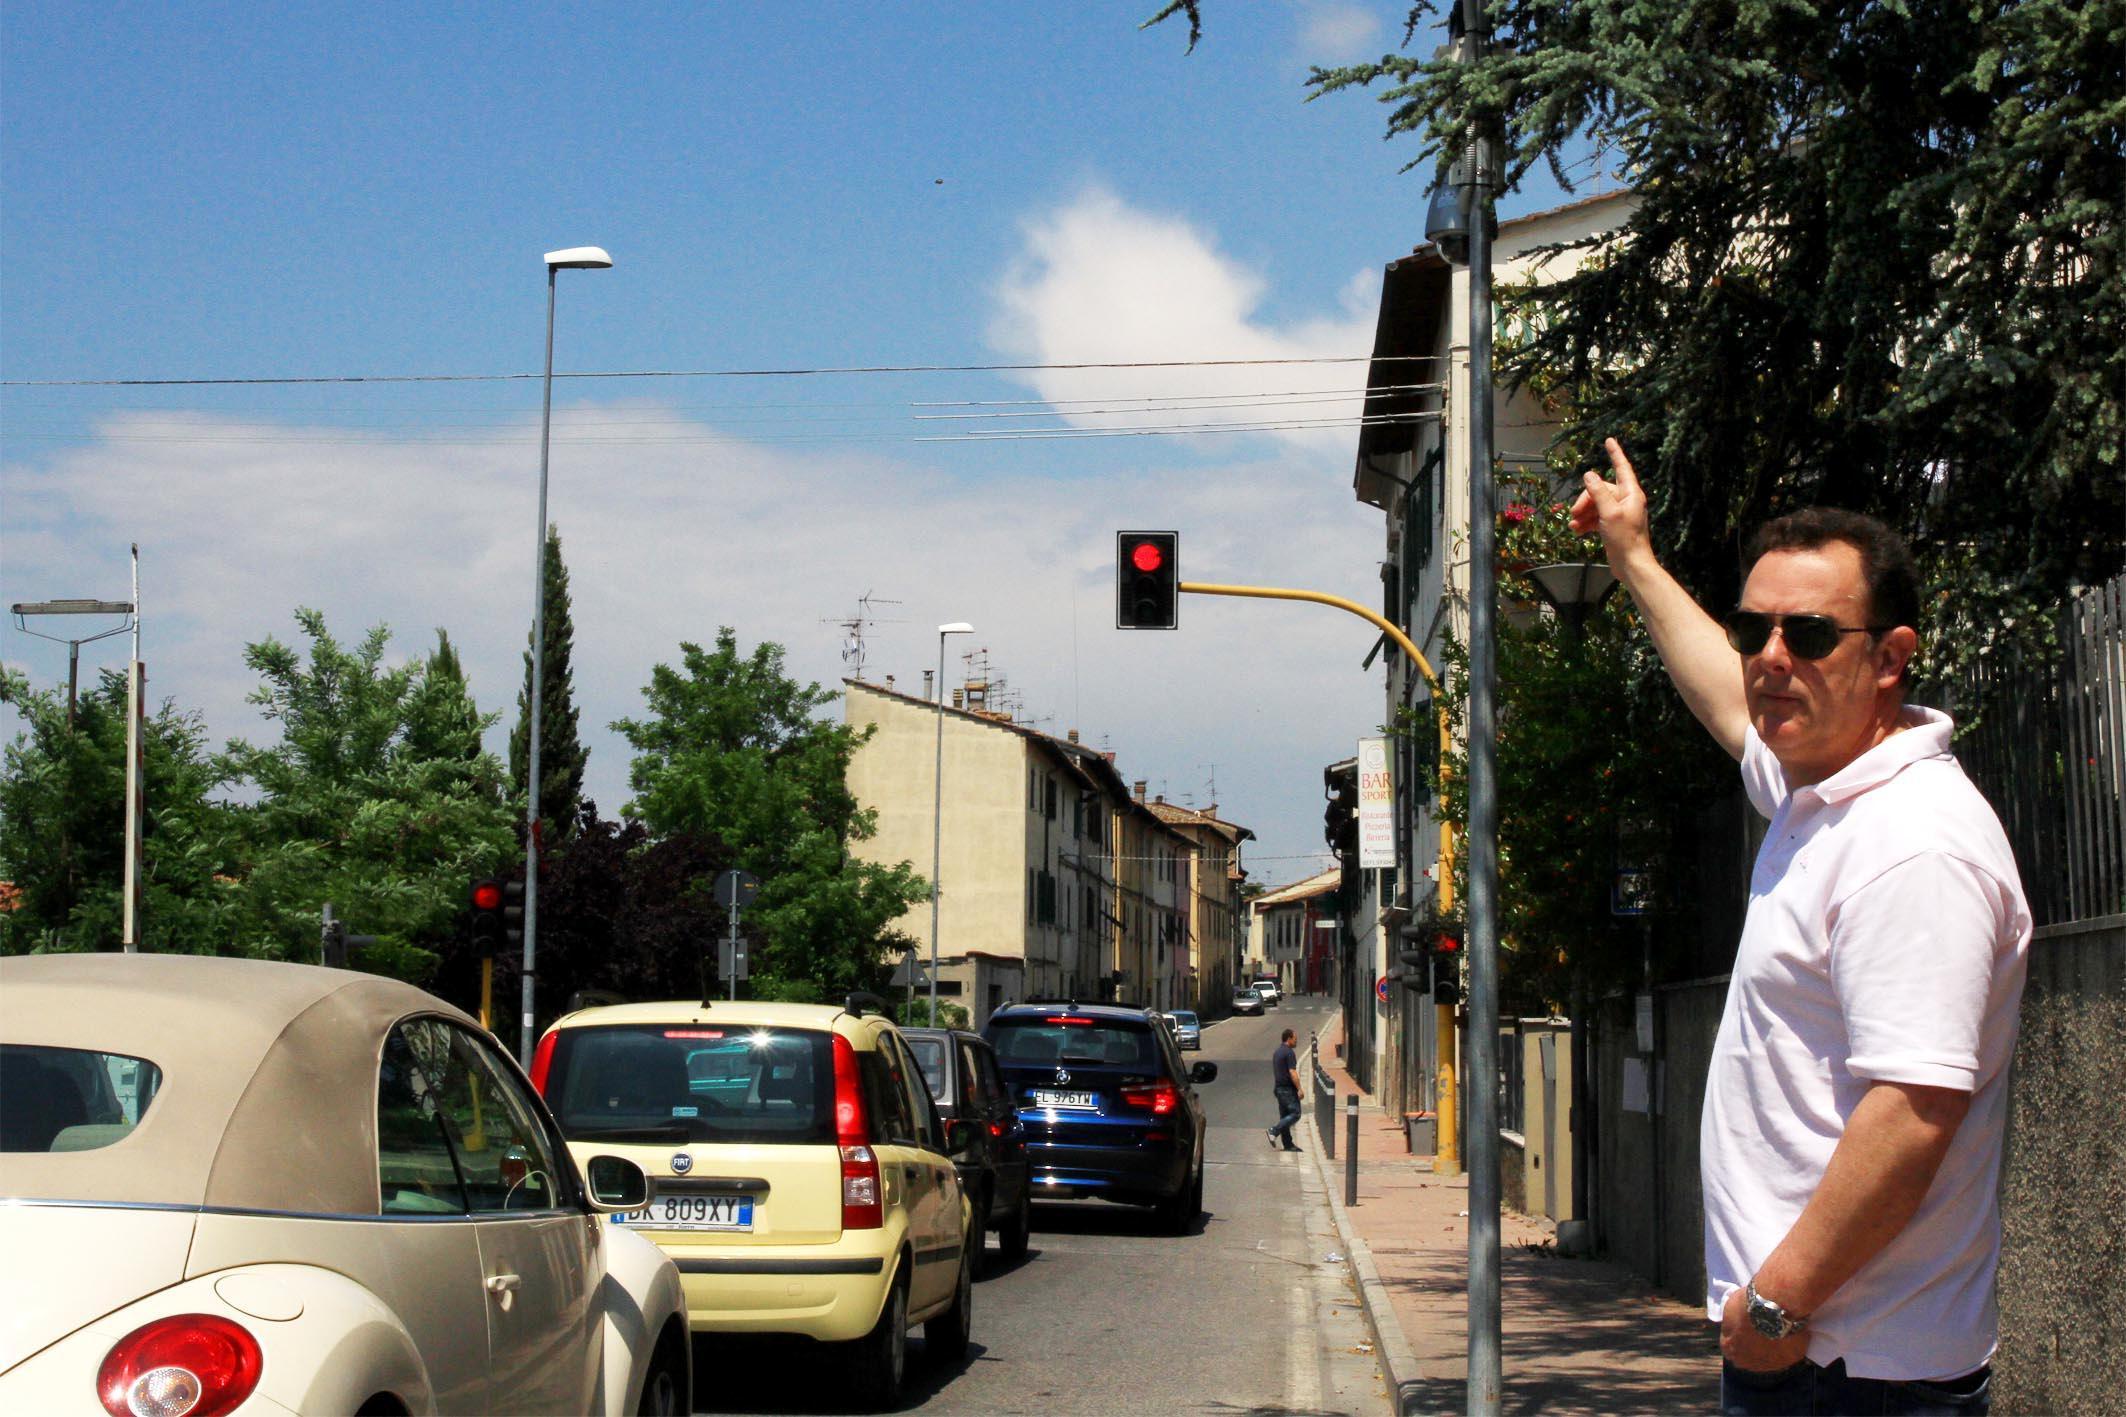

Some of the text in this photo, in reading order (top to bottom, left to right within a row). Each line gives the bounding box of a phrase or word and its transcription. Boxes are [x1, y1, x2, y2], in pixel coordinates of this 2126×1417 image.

[1361, 772, 1392, 789] BAR
[1361, 791, 1393, 801] SPORT
[673, 1158, 690, 1166] FIAT
[665, 1198, 737, 1222] 809XY
